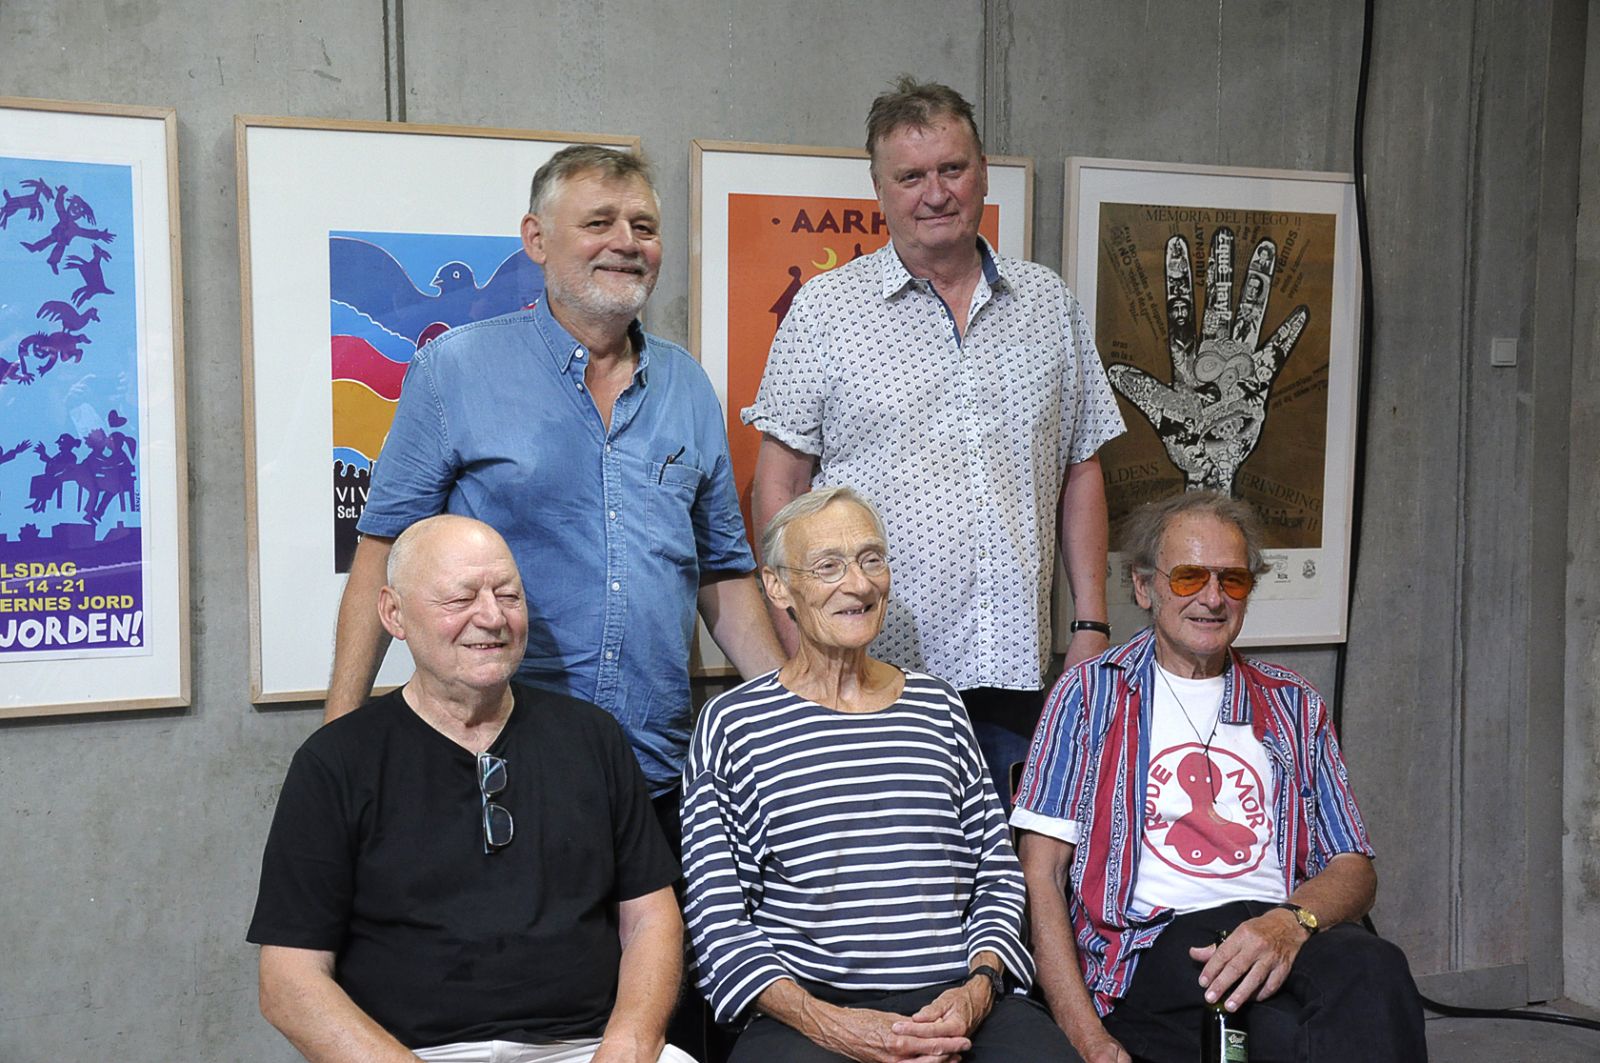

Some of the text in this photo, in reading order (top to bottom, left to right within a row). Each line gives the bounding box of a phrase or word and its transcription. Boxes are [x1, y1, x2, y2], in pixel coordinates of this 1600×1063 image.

[791, 208, 890, 235] AARH
[1145, 208, 1211, 223] MEMORIA
[1215, 211, 1240, 224] DEL
[1245, 212, 1289, 226] FUEGO
[336, 486, 371, 503] VIV
[1240, 471, 1321, 513] ERINDRING
[0, 562, 77, 578] LSDAG
[0, 581, 18, 594] L.
[25, 580, 49, 593] 14
[0, 595, 134, 612] ERNES JORD
[0, 610, 143, 648] JORDEN!
[1226, 768, 1265, 829] MOR
